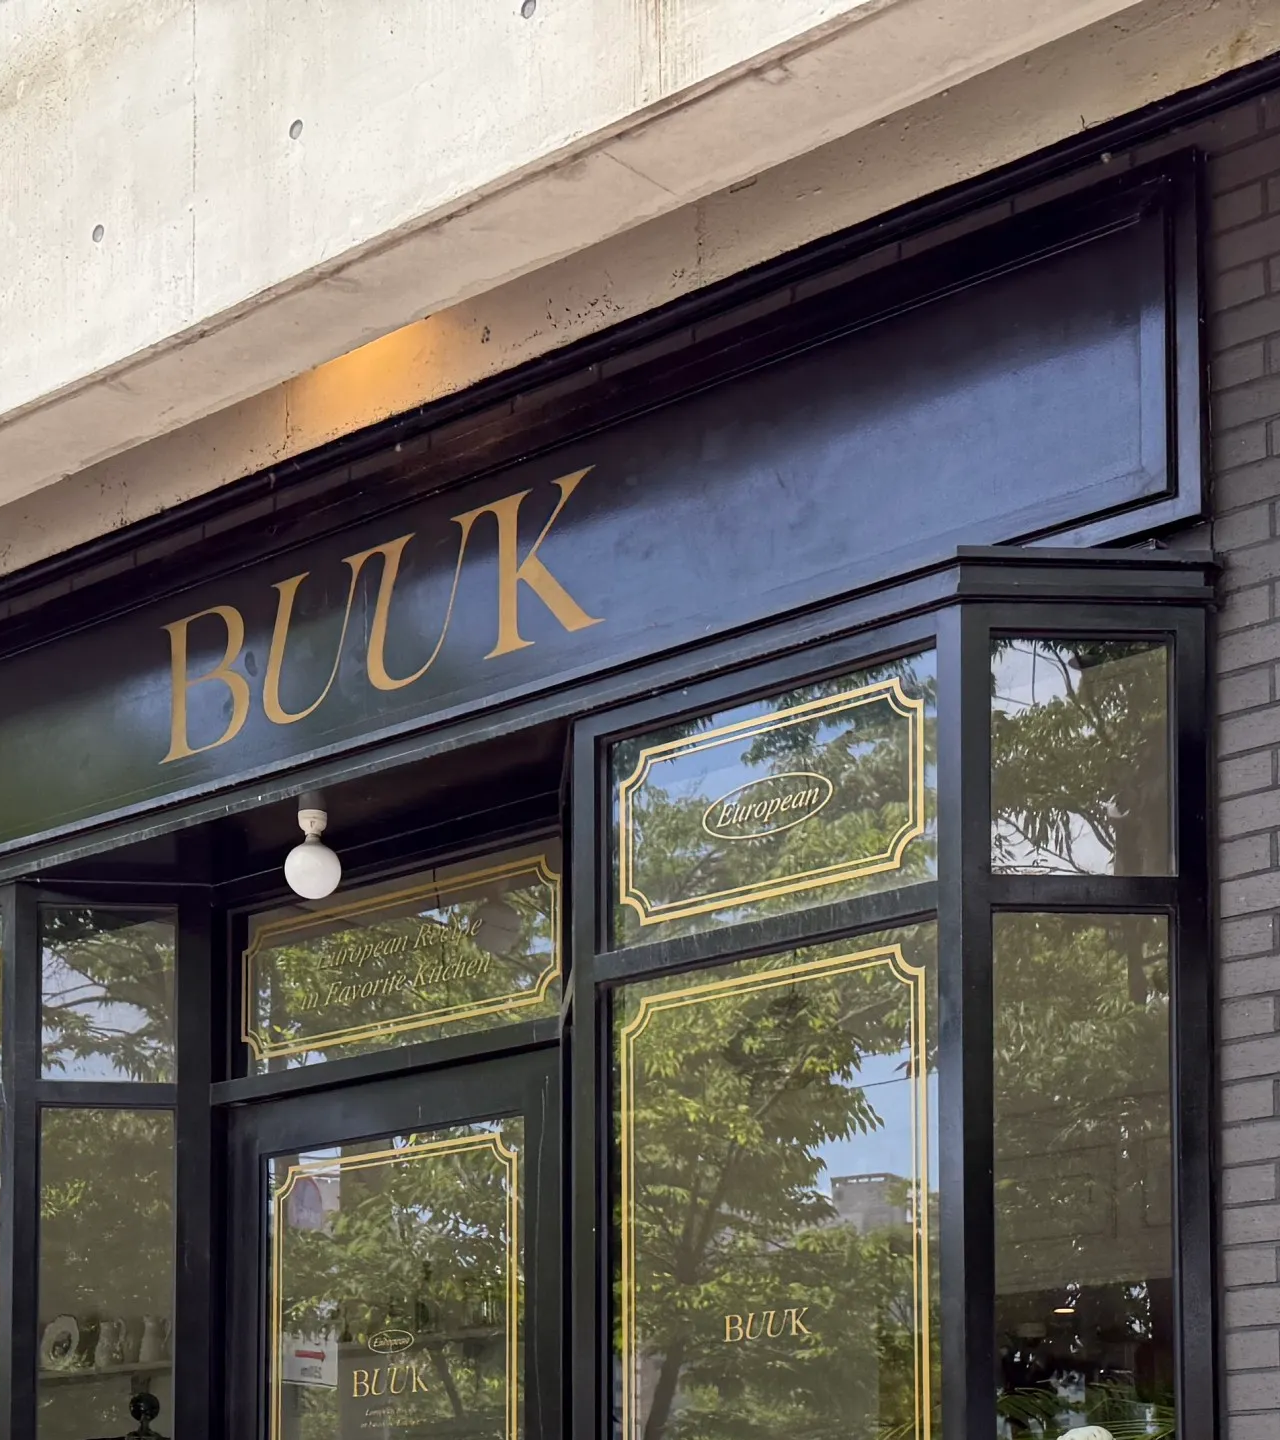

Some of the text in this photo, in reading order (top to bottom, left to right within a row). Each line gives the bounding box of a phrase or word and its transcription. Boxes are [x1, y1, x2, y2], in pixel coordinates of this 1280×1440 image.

[158, 464, 606, 765] BUUK
[716, 786, 821, 828] European
[301, 990, 319, 1010] in
[324, 973, 407, 1007] Favorite
[723, 1307, 813, 1343] BUUK
[352, 1365, 429, 1398] BUUK
